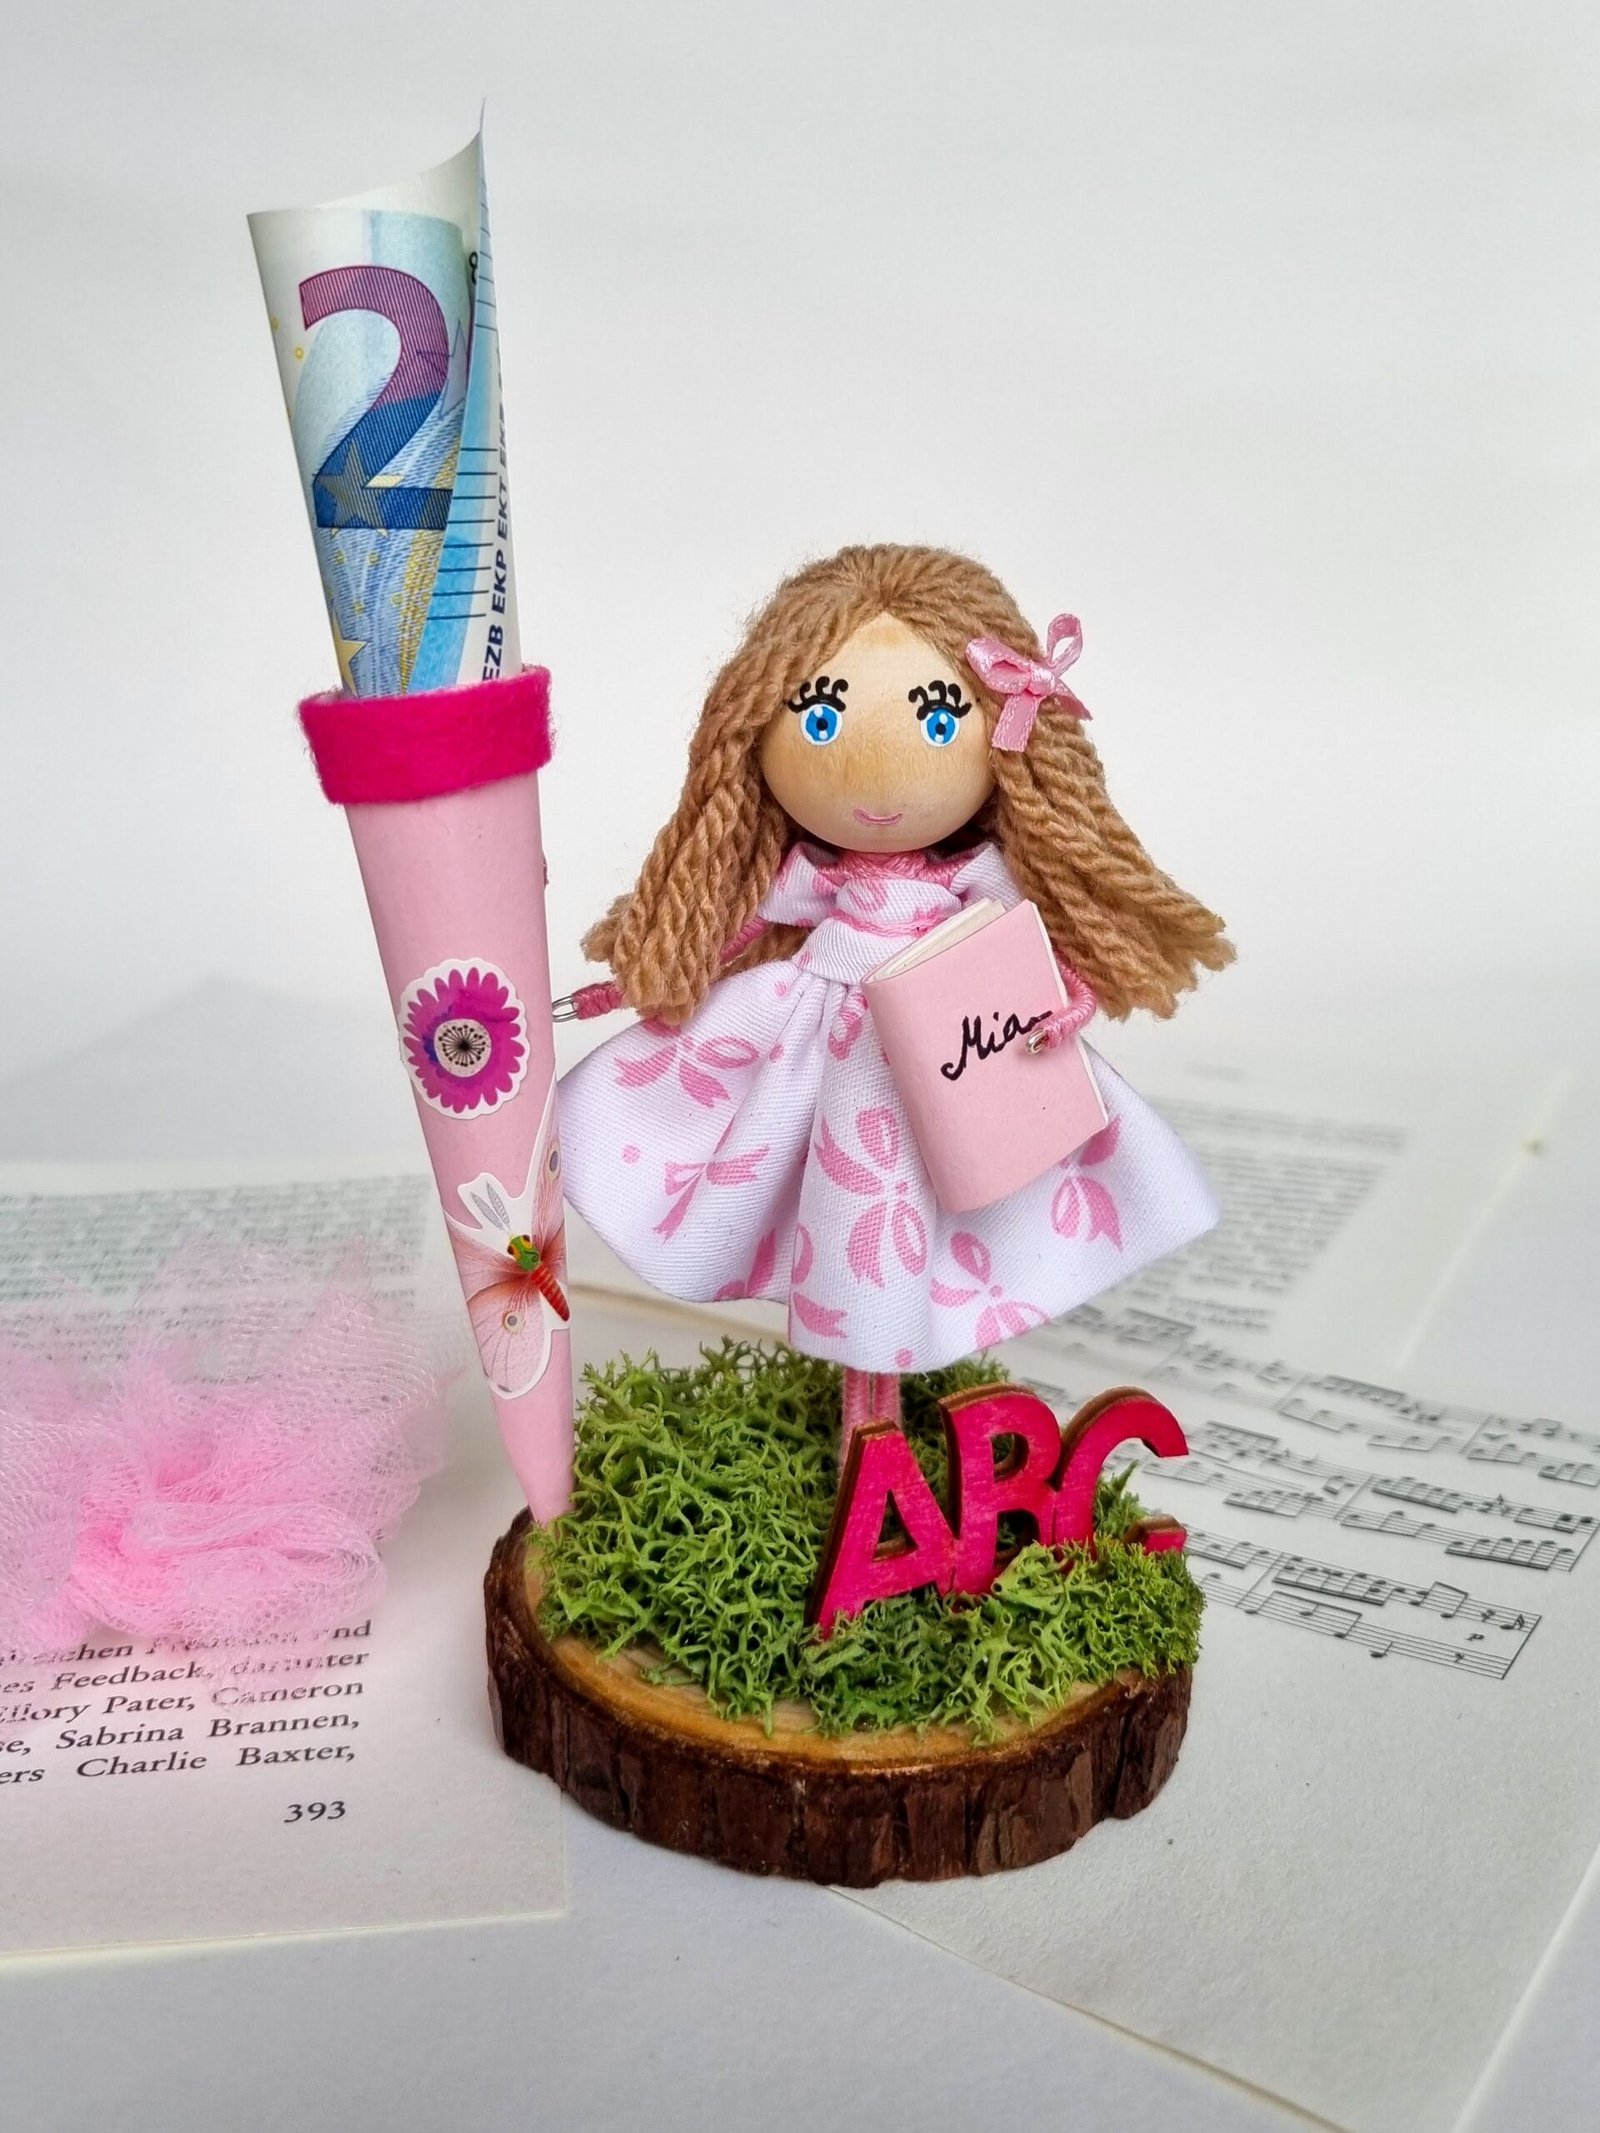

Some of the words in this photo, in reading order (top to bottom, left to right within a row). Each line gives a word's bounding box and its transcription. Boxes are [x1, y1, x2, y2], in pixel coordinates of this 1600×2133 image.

[298, 264, 454, 531] 2
[497, 475, 508, 541] EKT
[491, 548, 508, 616] EKP
[482, 624, 504, 682] EZB
[940, 1010, 1054, 1081] Mia
[804, 1382, 1189, 1642] ABC
[101, 1695, 196, 1715] Pater,
[212, 1681, 364, 1707] Cameron
[55, 1723, 184, 1750] Sabrina
[207, 1712, 360, 1739] Brannen,
[76, 1751, 208, 1777] Charlie
[235, 1744, 356, 1767] Baxter,
[283, 1800, 347, 1824] 393
